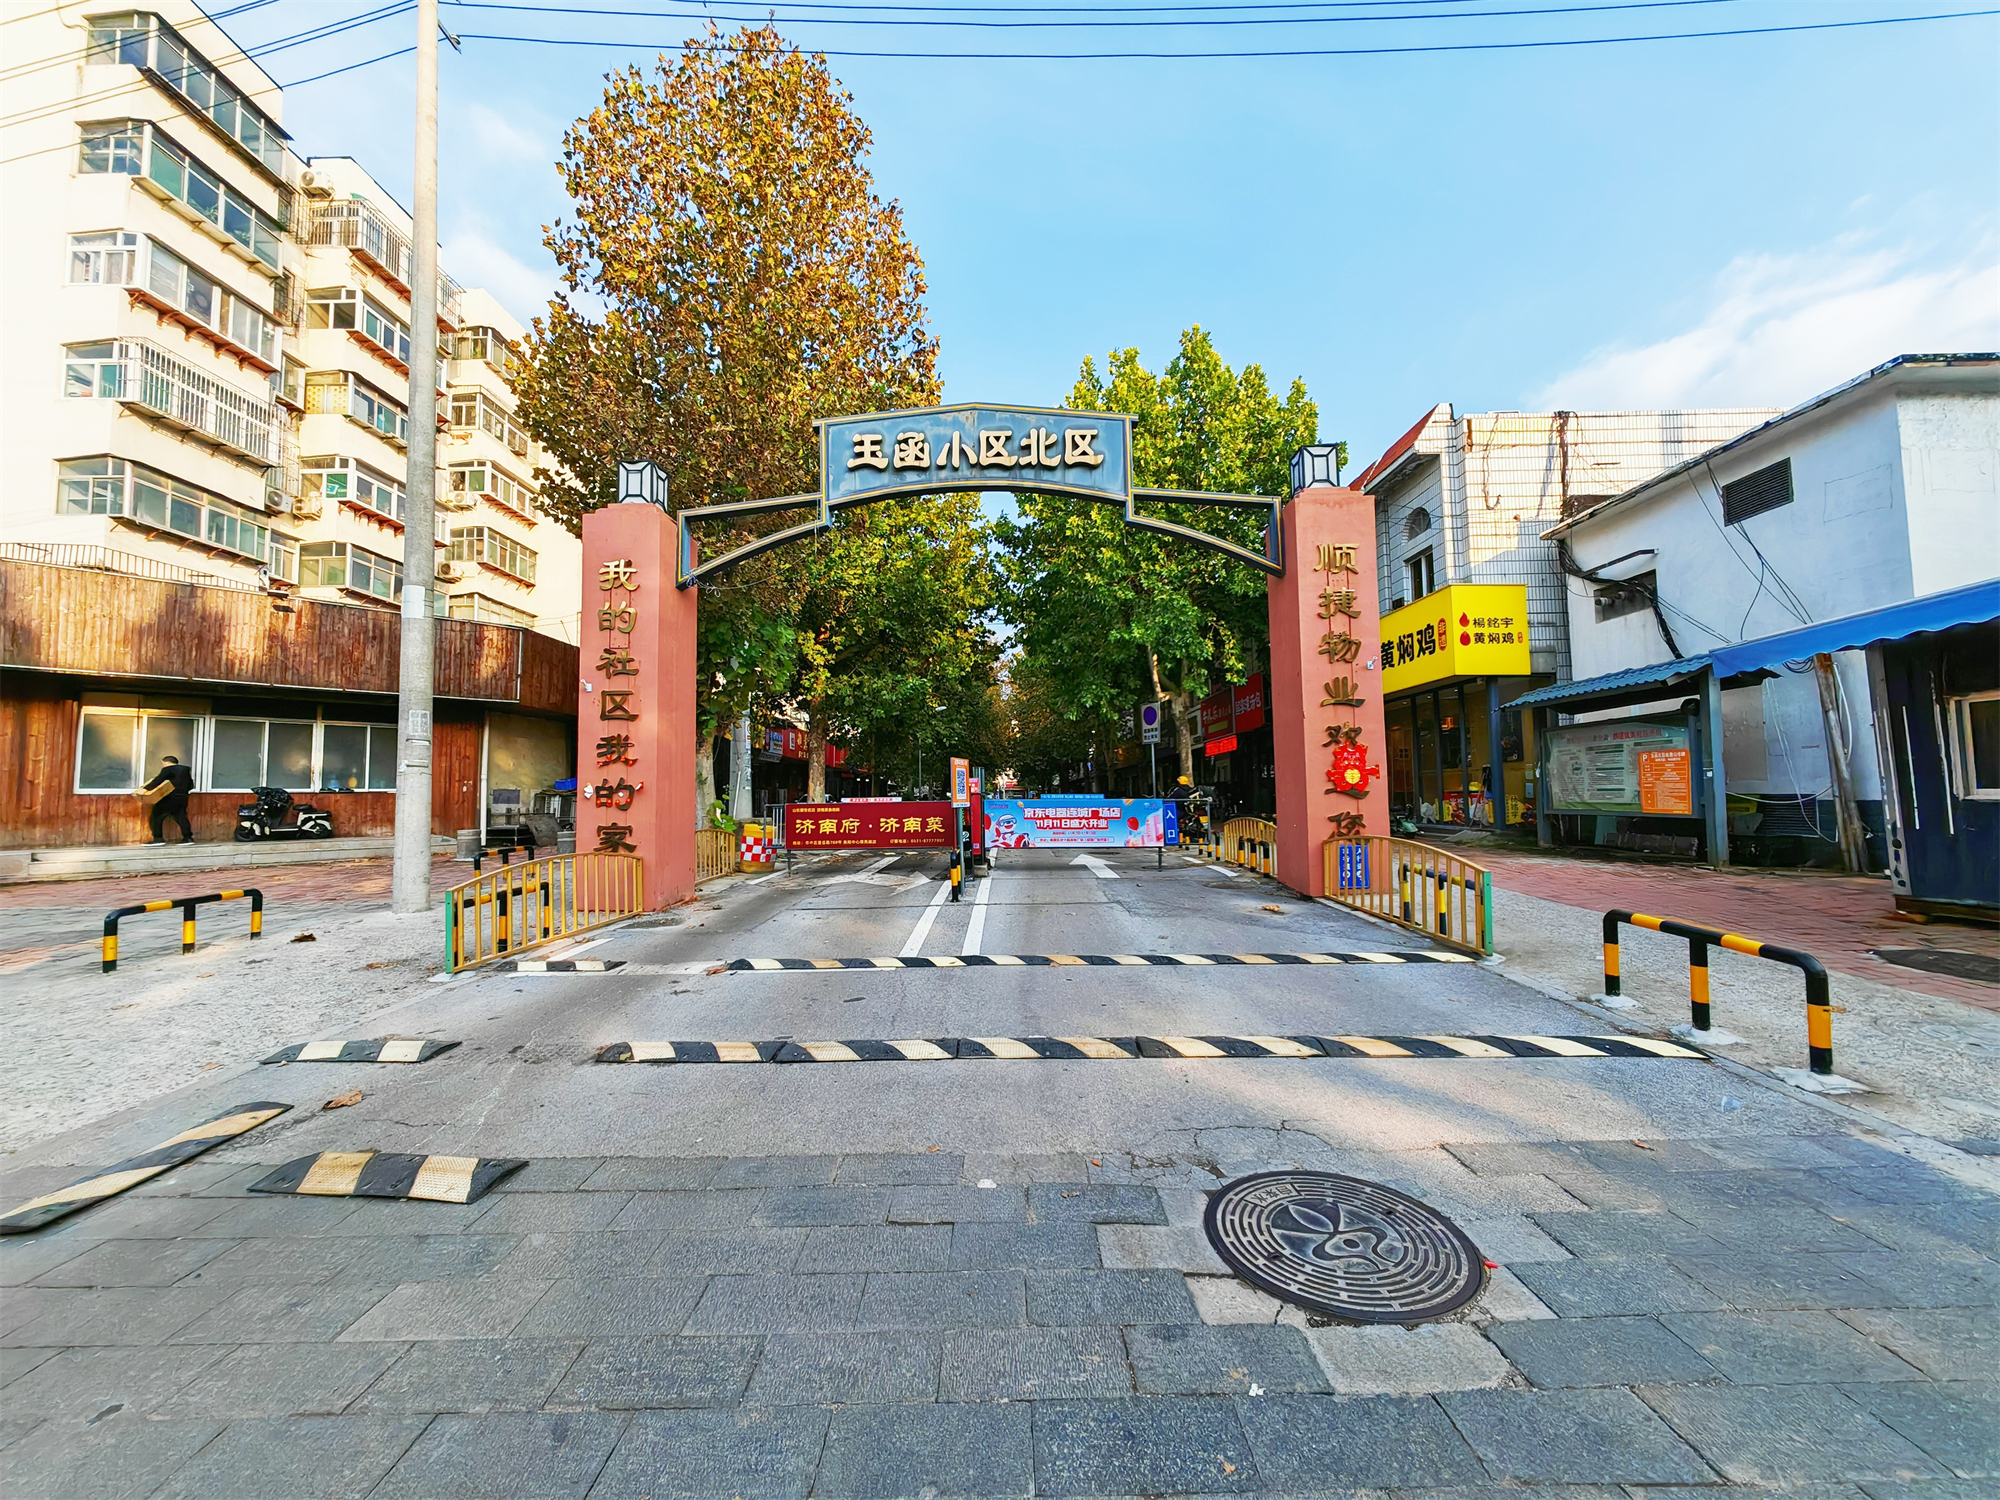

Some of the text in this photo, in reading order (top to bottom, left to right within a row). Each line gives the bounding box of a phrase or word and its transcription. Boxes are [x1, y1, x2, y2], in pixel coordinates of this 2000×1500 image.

[847, 428, 1105, 470] 玉函小区北区
[1380, 623, 1437, 671] 黄焖鸡
[1473, 632, 1515, 645] 黄焖鸡
[1313, 542, 1370, 840] 顺捷物业欢您
[593, 558, 641, 853] 我的社区我的家
[1642, 754, 1648, 762] P
[1024, 807, 1121, 818] 京东电器连城广场店
[1036, 819, 1107, 828] 11月11日盛大开业
[1165, 809, 1176, 838] 入口
[1250, 1185, 1293, 1204] 自来水
